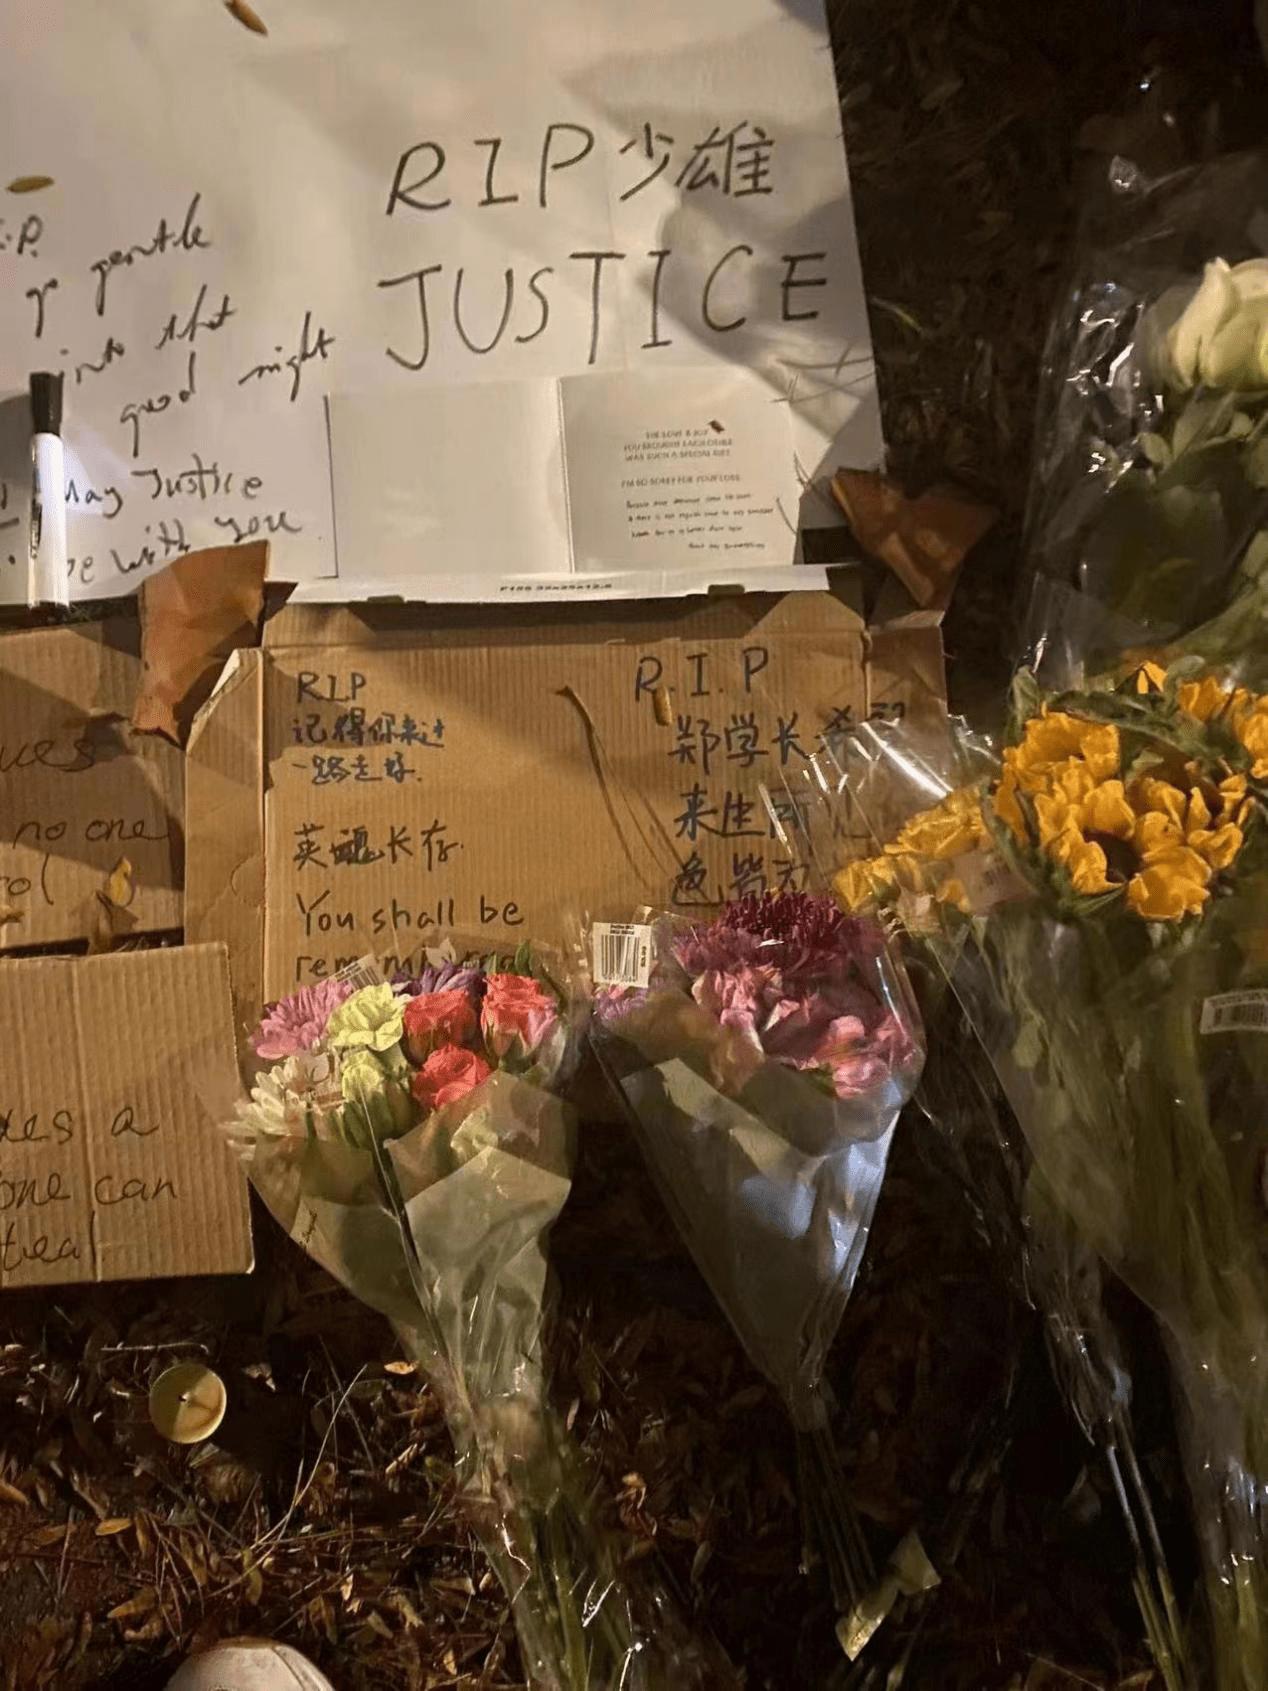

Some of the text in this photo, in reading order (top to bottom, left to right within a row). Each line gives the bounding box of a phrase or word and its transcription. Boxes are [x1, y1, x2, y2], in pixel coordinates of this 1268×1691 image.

[386, 119, 775, 215] RIP 少雄
[376, 244, 828, 371] JUSTICE
[119, 310, 336, 459] good night
[130, 453, 263, 502] Justice
[213, 510, 303, 544] you
[12, 817, 169, 850] no one
[296, 888, 525, 937] You shall be
[111, 1105, 160, 1138] a
[93, 1174, 179, 1206] can
